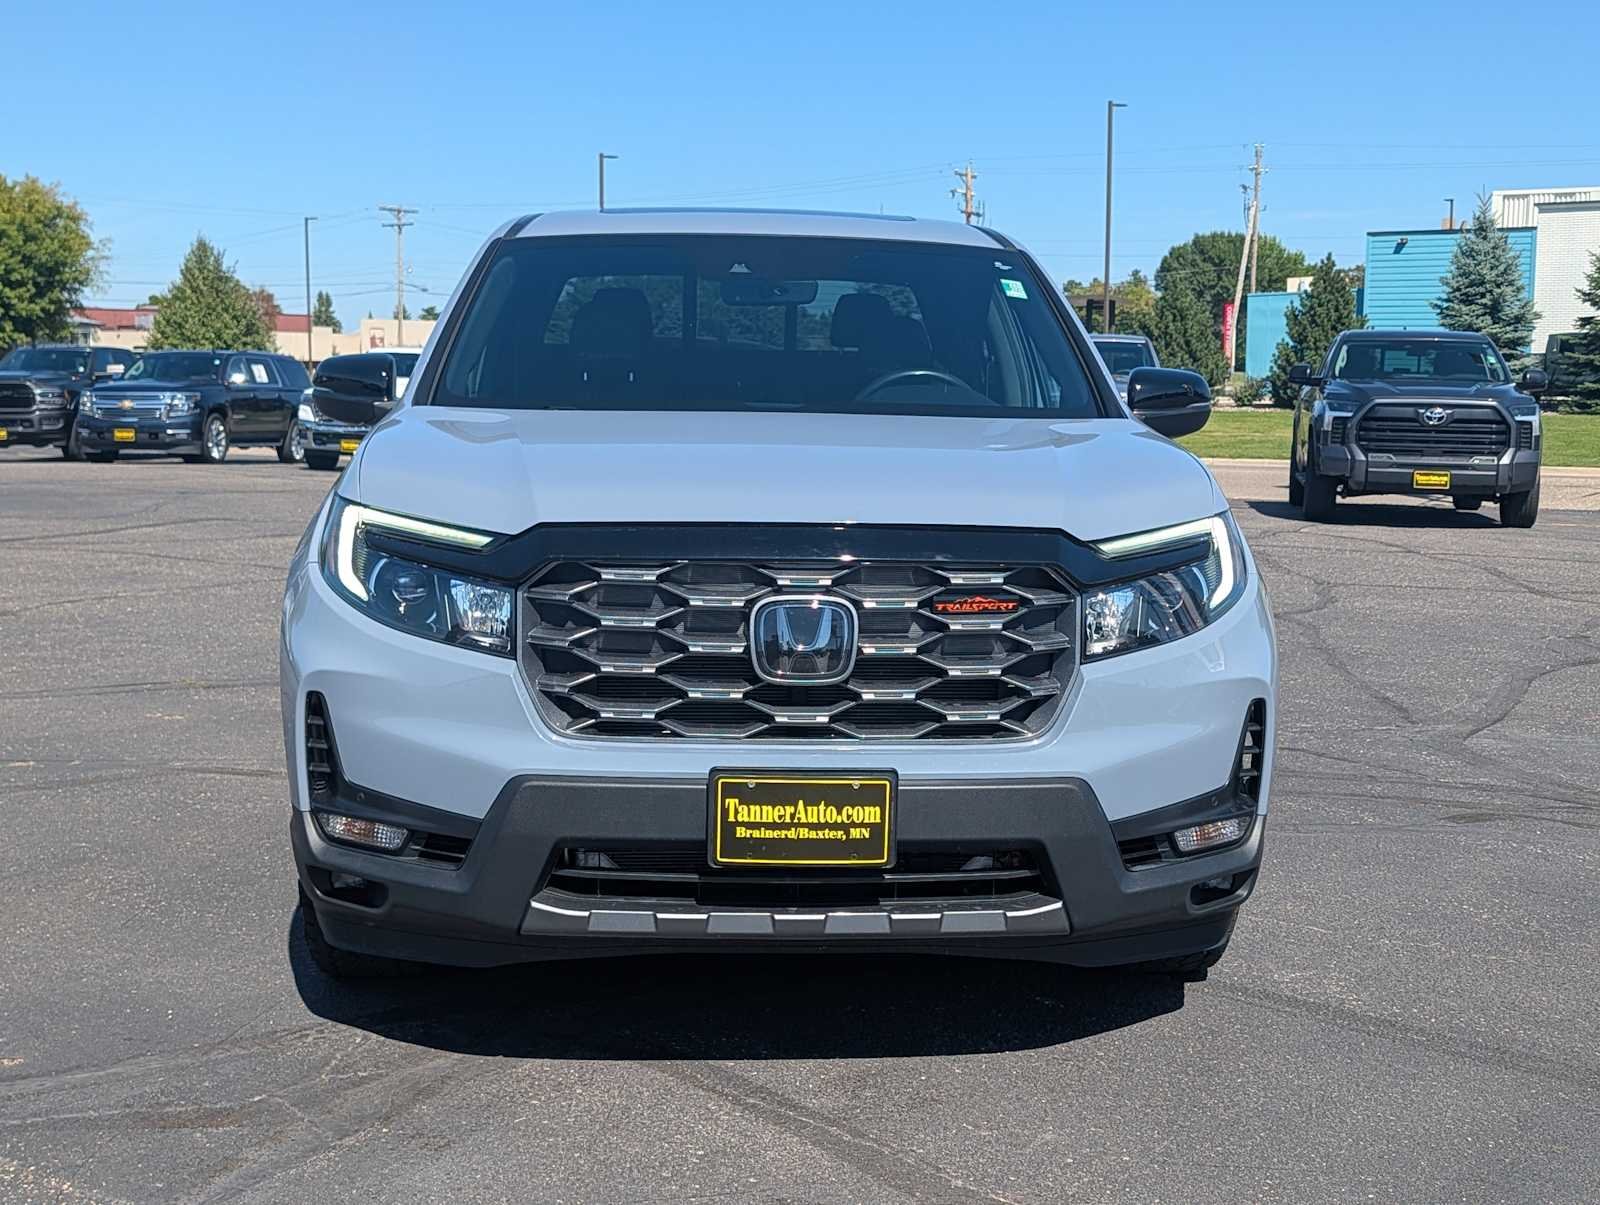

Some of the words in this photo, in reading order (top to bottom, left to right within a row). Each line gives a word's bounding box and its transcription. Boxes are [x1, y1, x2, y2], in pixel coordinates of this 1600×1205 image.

[935, 602, 1017, 612] TRAILSPORT
[725, 798, 881, 824] TannerAuto.com
[736, 827, 846, 841] Brainerd/Baxter,
[849, 828, 870, 839] MN
